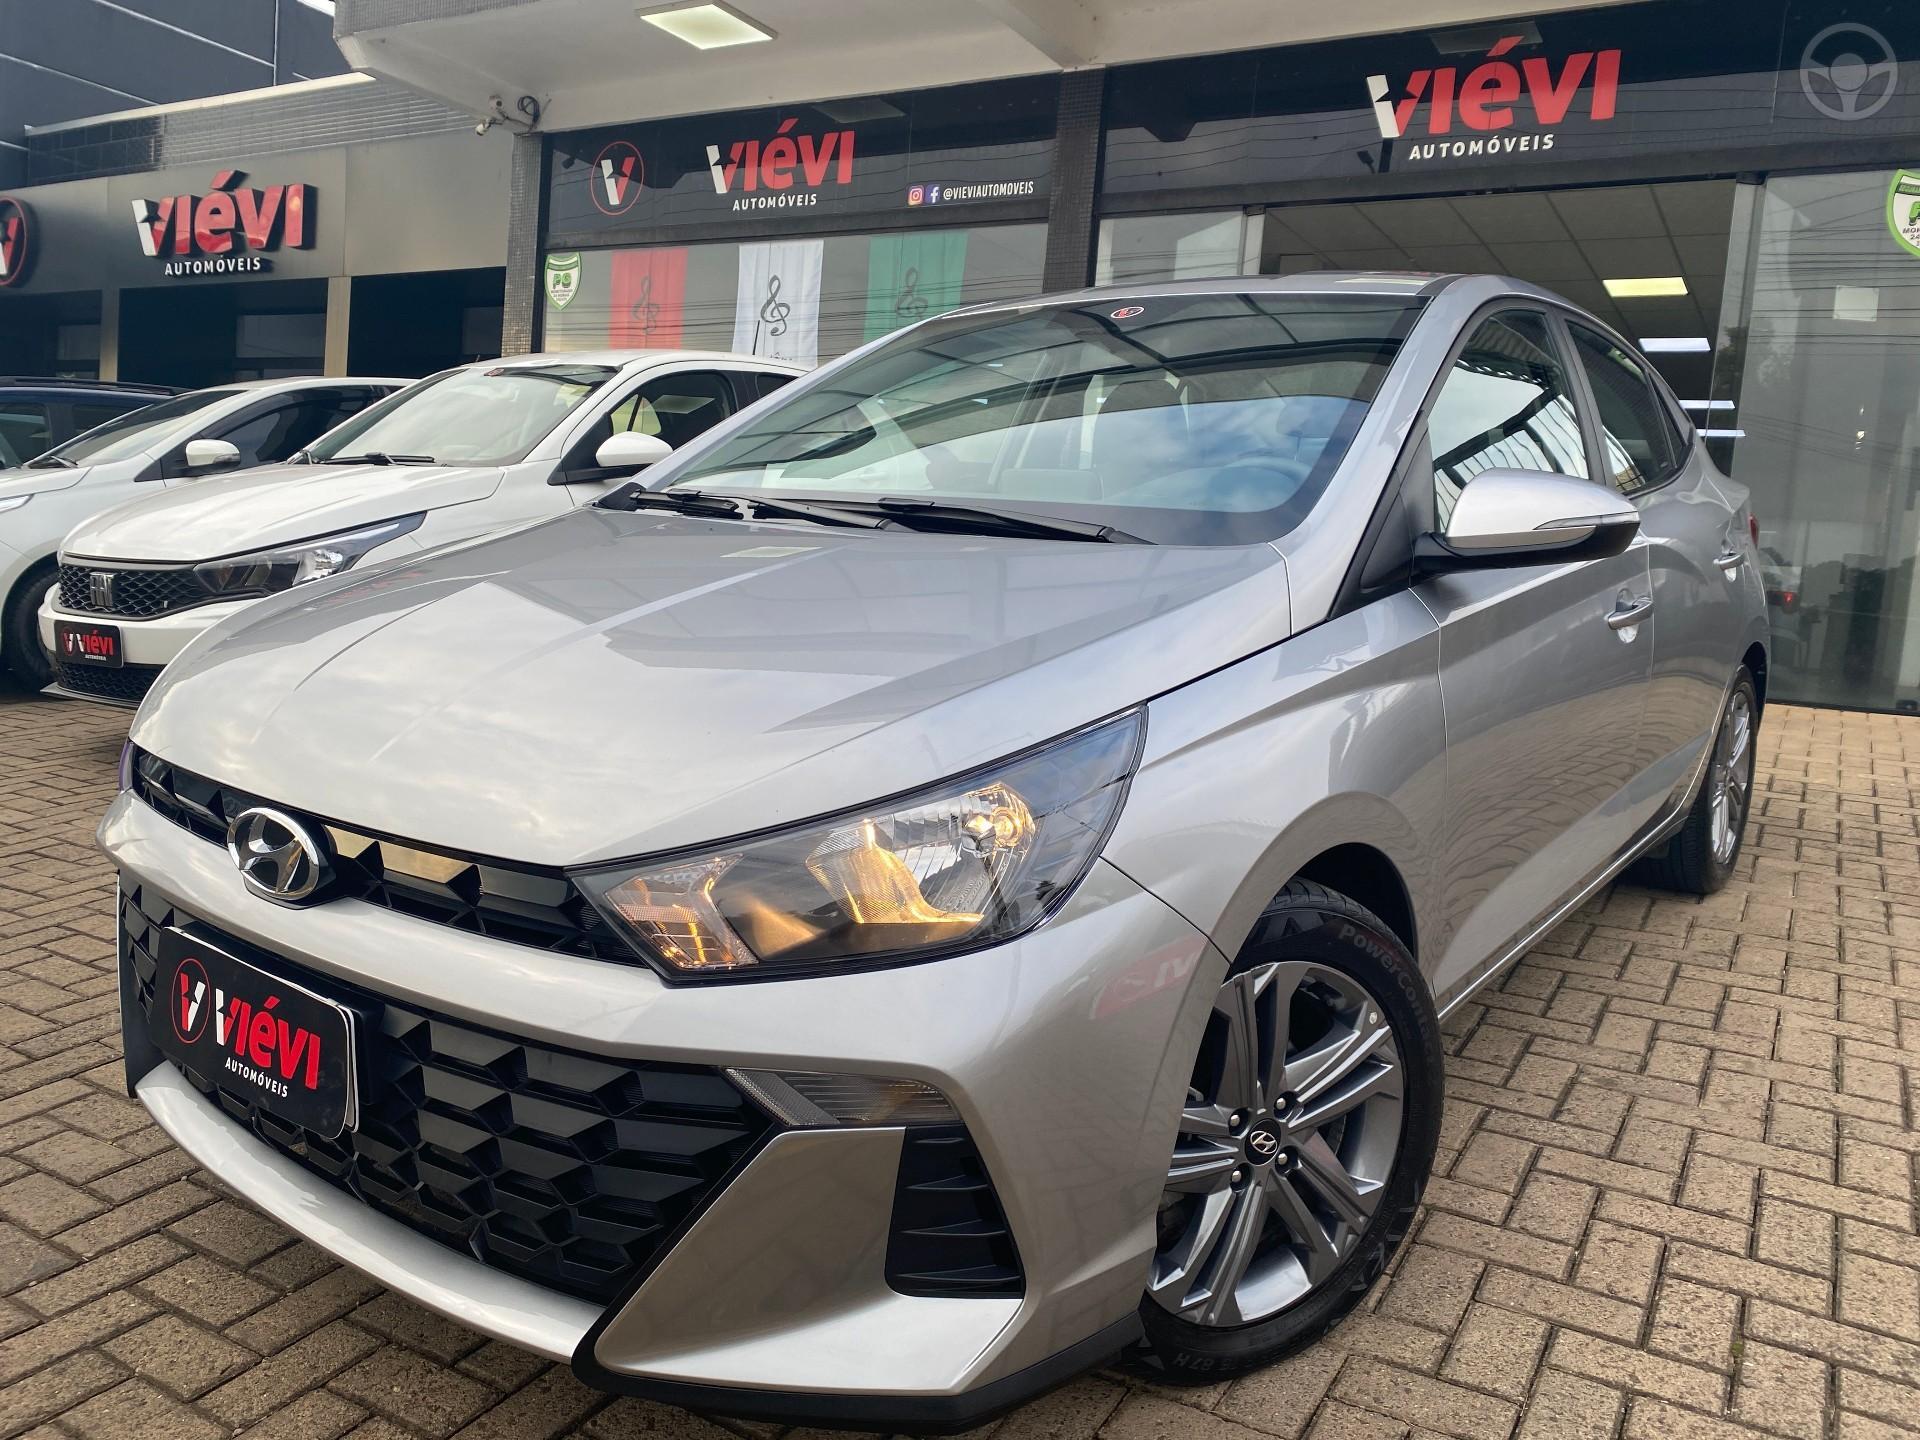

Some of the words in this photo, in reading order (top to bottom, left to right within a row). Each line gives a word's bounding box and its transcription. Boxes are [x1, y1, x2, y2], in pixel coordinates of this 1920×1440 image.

[1408, 133, 1555, 161] AUTOMÓVEIS
[943, 181, 1034, 200] @VIEVIAUTOMOVEIS
[732, 193, 817, 211] AUTOMÓVEIS
[164, 255, 262, 276] AUTOMÓVEIS
[225, 1056, 289, 1098] AUTOMÓVEIS
